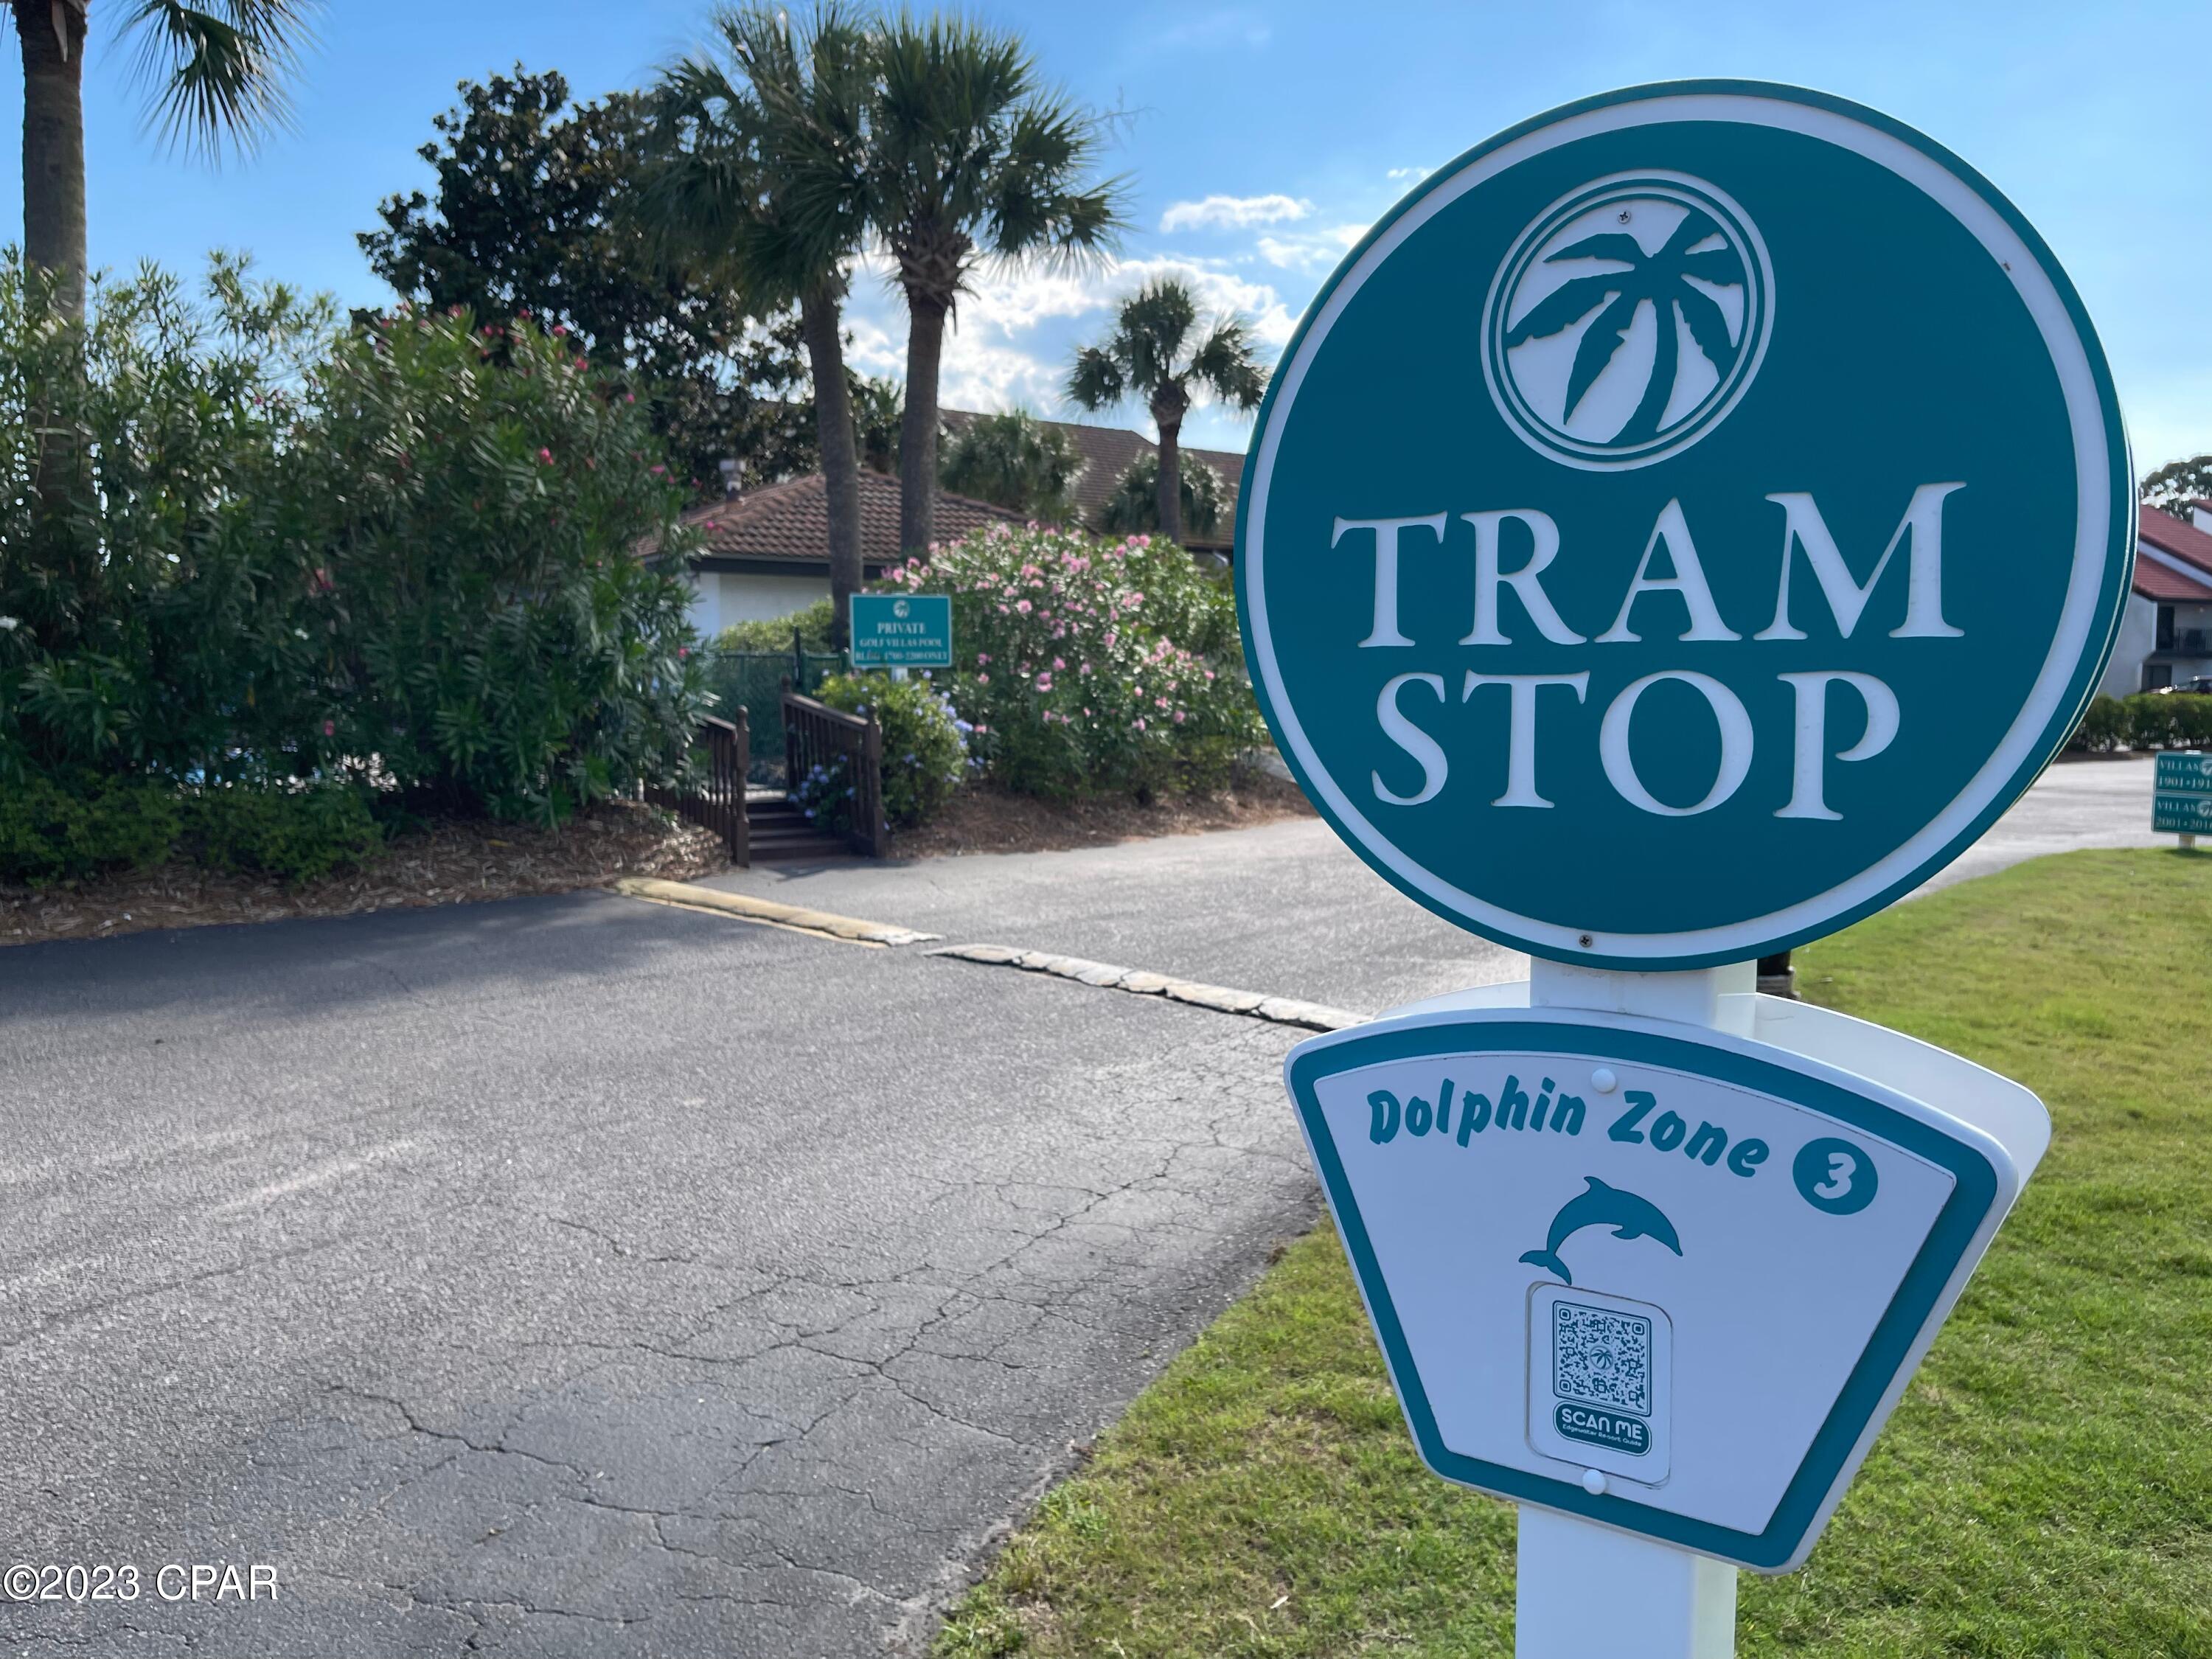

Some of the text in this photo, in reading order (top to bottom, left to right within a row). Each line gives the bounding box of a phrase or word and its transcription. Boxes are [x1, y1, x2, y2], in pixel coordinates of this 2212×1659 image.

[1330, 481, 1967, 647] TRAM
[877, 622, 927, 634] PRIVATE
[859, 638, 943, 647] GOLF VILLAS POOL
[1371, 669, 1900, 820] STOP
[2159, 760, 2199, 771] VILLAS
[2157, 801, 2196, 813] VILLAS
[1367, 1074, 1856, 1200] Dolphin Zone 3
[1562, 1408, 1642, 1440] SCAN ME
[1562, 1424, 1642, 1447] Edgewater Resort Guide
